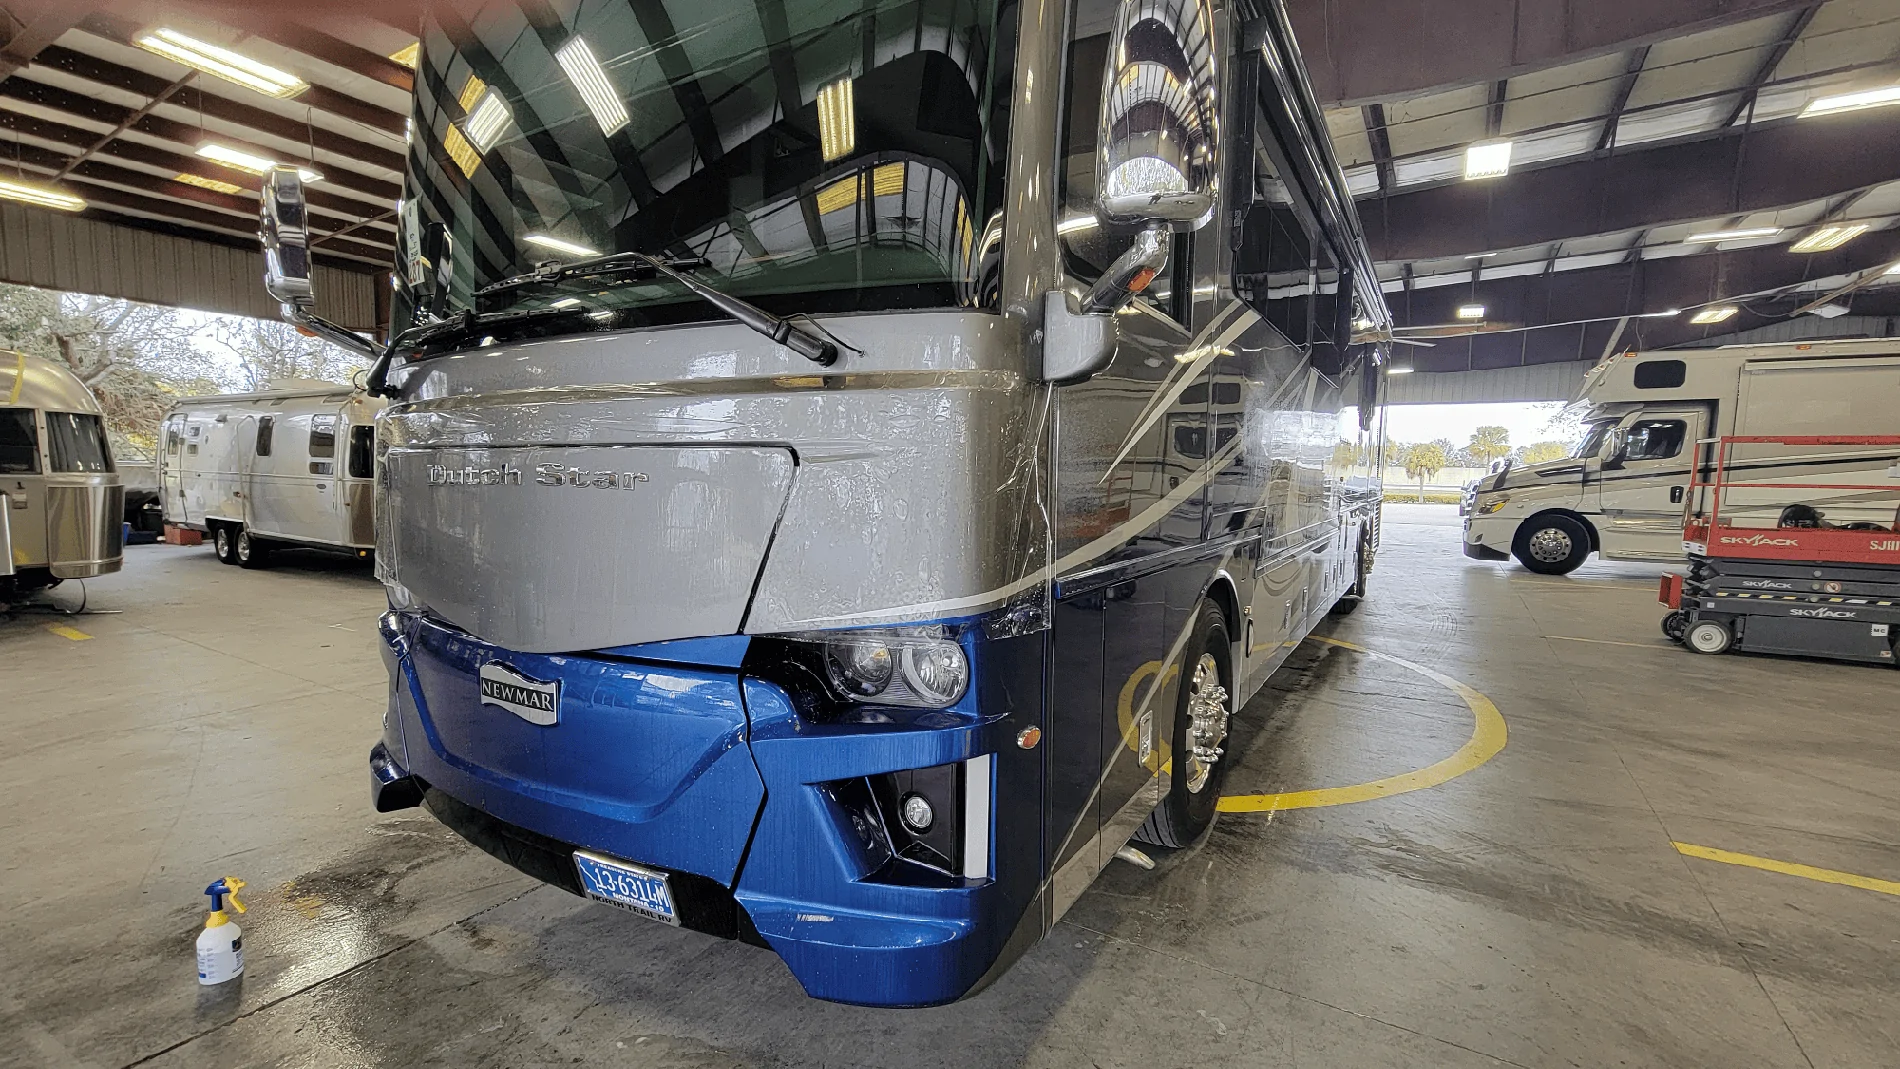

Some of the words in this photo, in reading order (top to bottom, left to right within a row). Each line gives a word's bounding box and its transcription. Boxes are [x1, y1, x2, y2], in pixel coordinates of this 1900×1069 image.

[427, 463, 523, 486] Dutch
[535, 462, 650, 491] Star
[1720, 534, 1799, 547] SKYJACK
[1742, 579, 1792, 589] SKYJACK
[1789, 607, 1857, 619] SKYJACK
[482, 679, 554, 711] NEWMAR
[592, 894, 625, 909] NORTH
[627, 904, 657, 919] TRAIL
[658, 915, 672, 923] RV
